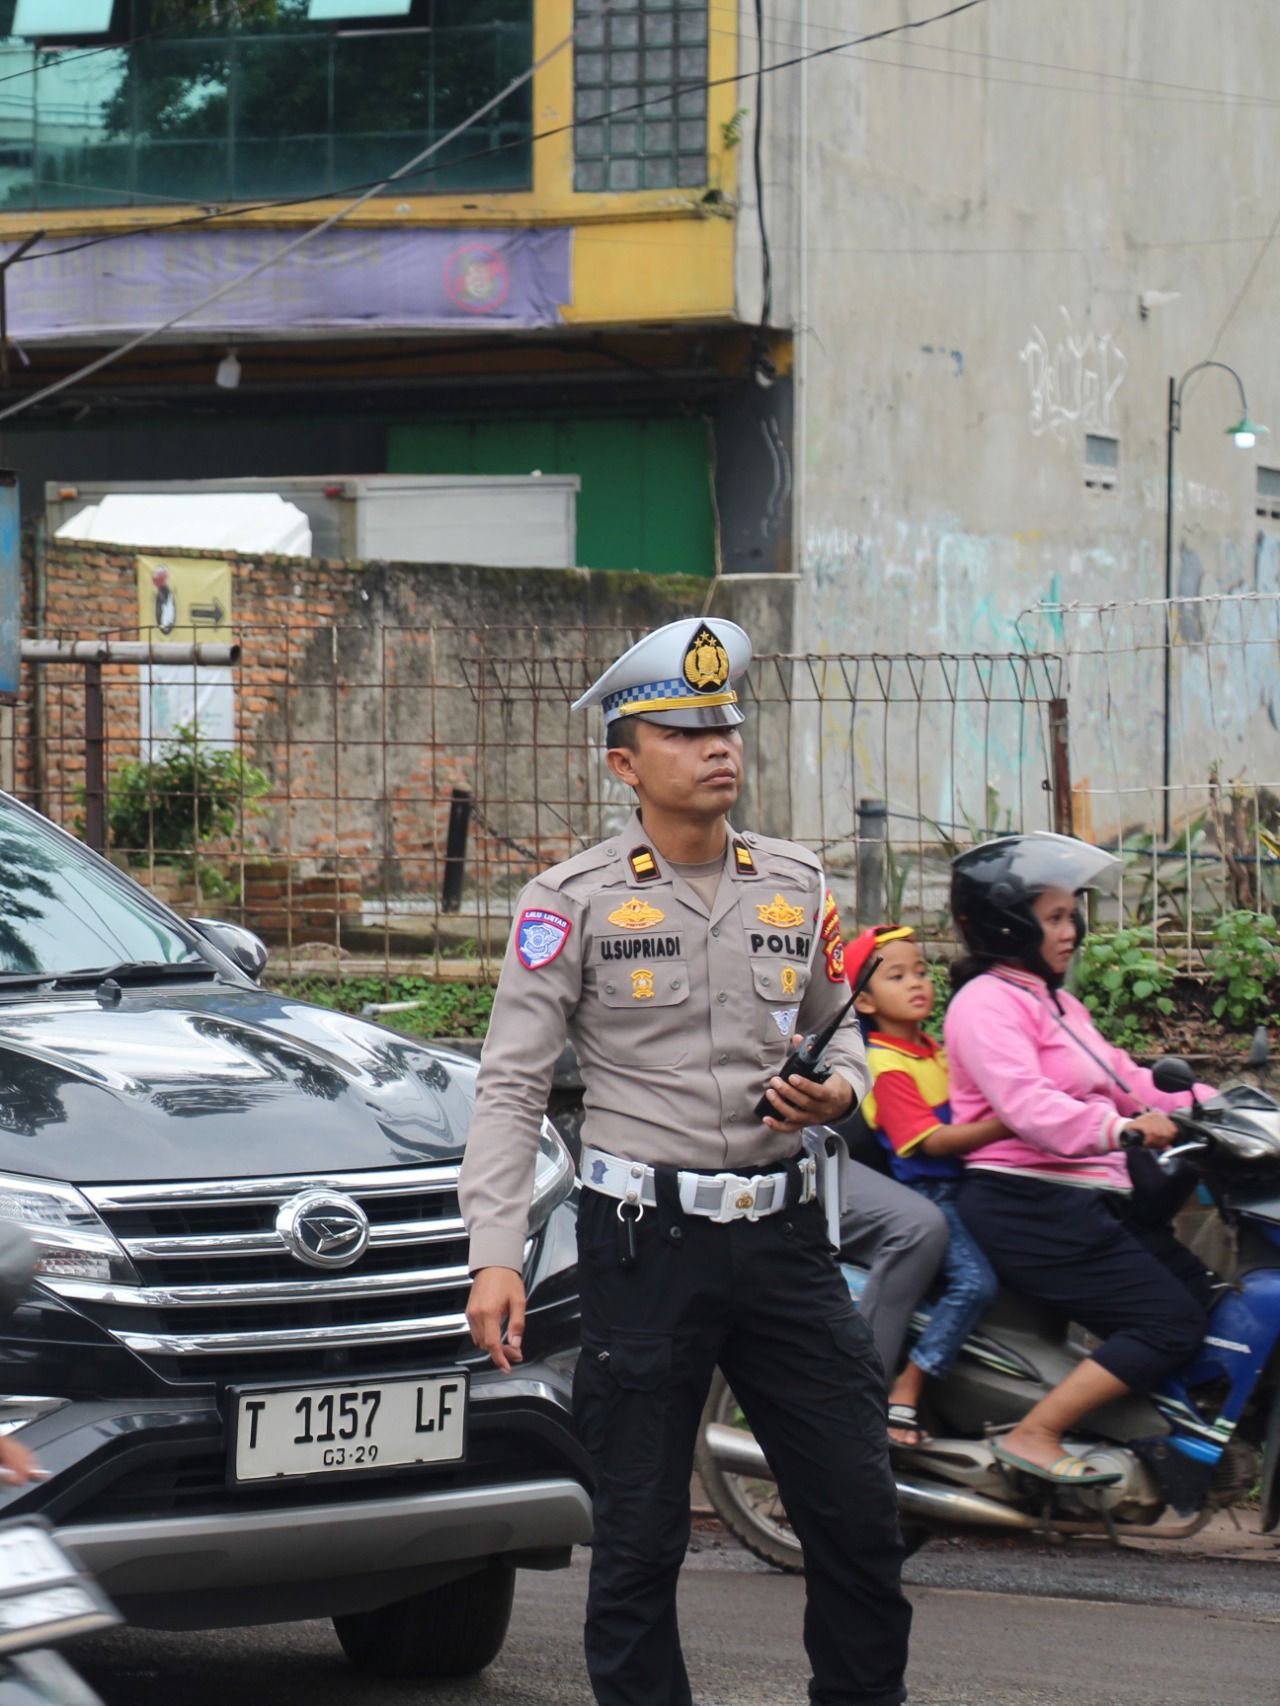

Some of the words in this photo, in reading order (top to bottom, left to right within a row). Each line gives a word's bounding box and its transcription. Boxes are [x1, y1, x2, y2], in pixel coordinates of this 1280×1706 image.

[600, 936, 681, 960] U.SUPRIADI
[750, 933, 810, 958] POLRI
[245, 1401, 266, 1449] T
[293, 1390, 382, 1445] 1157
[415, 1384, 458, 1433] LF
